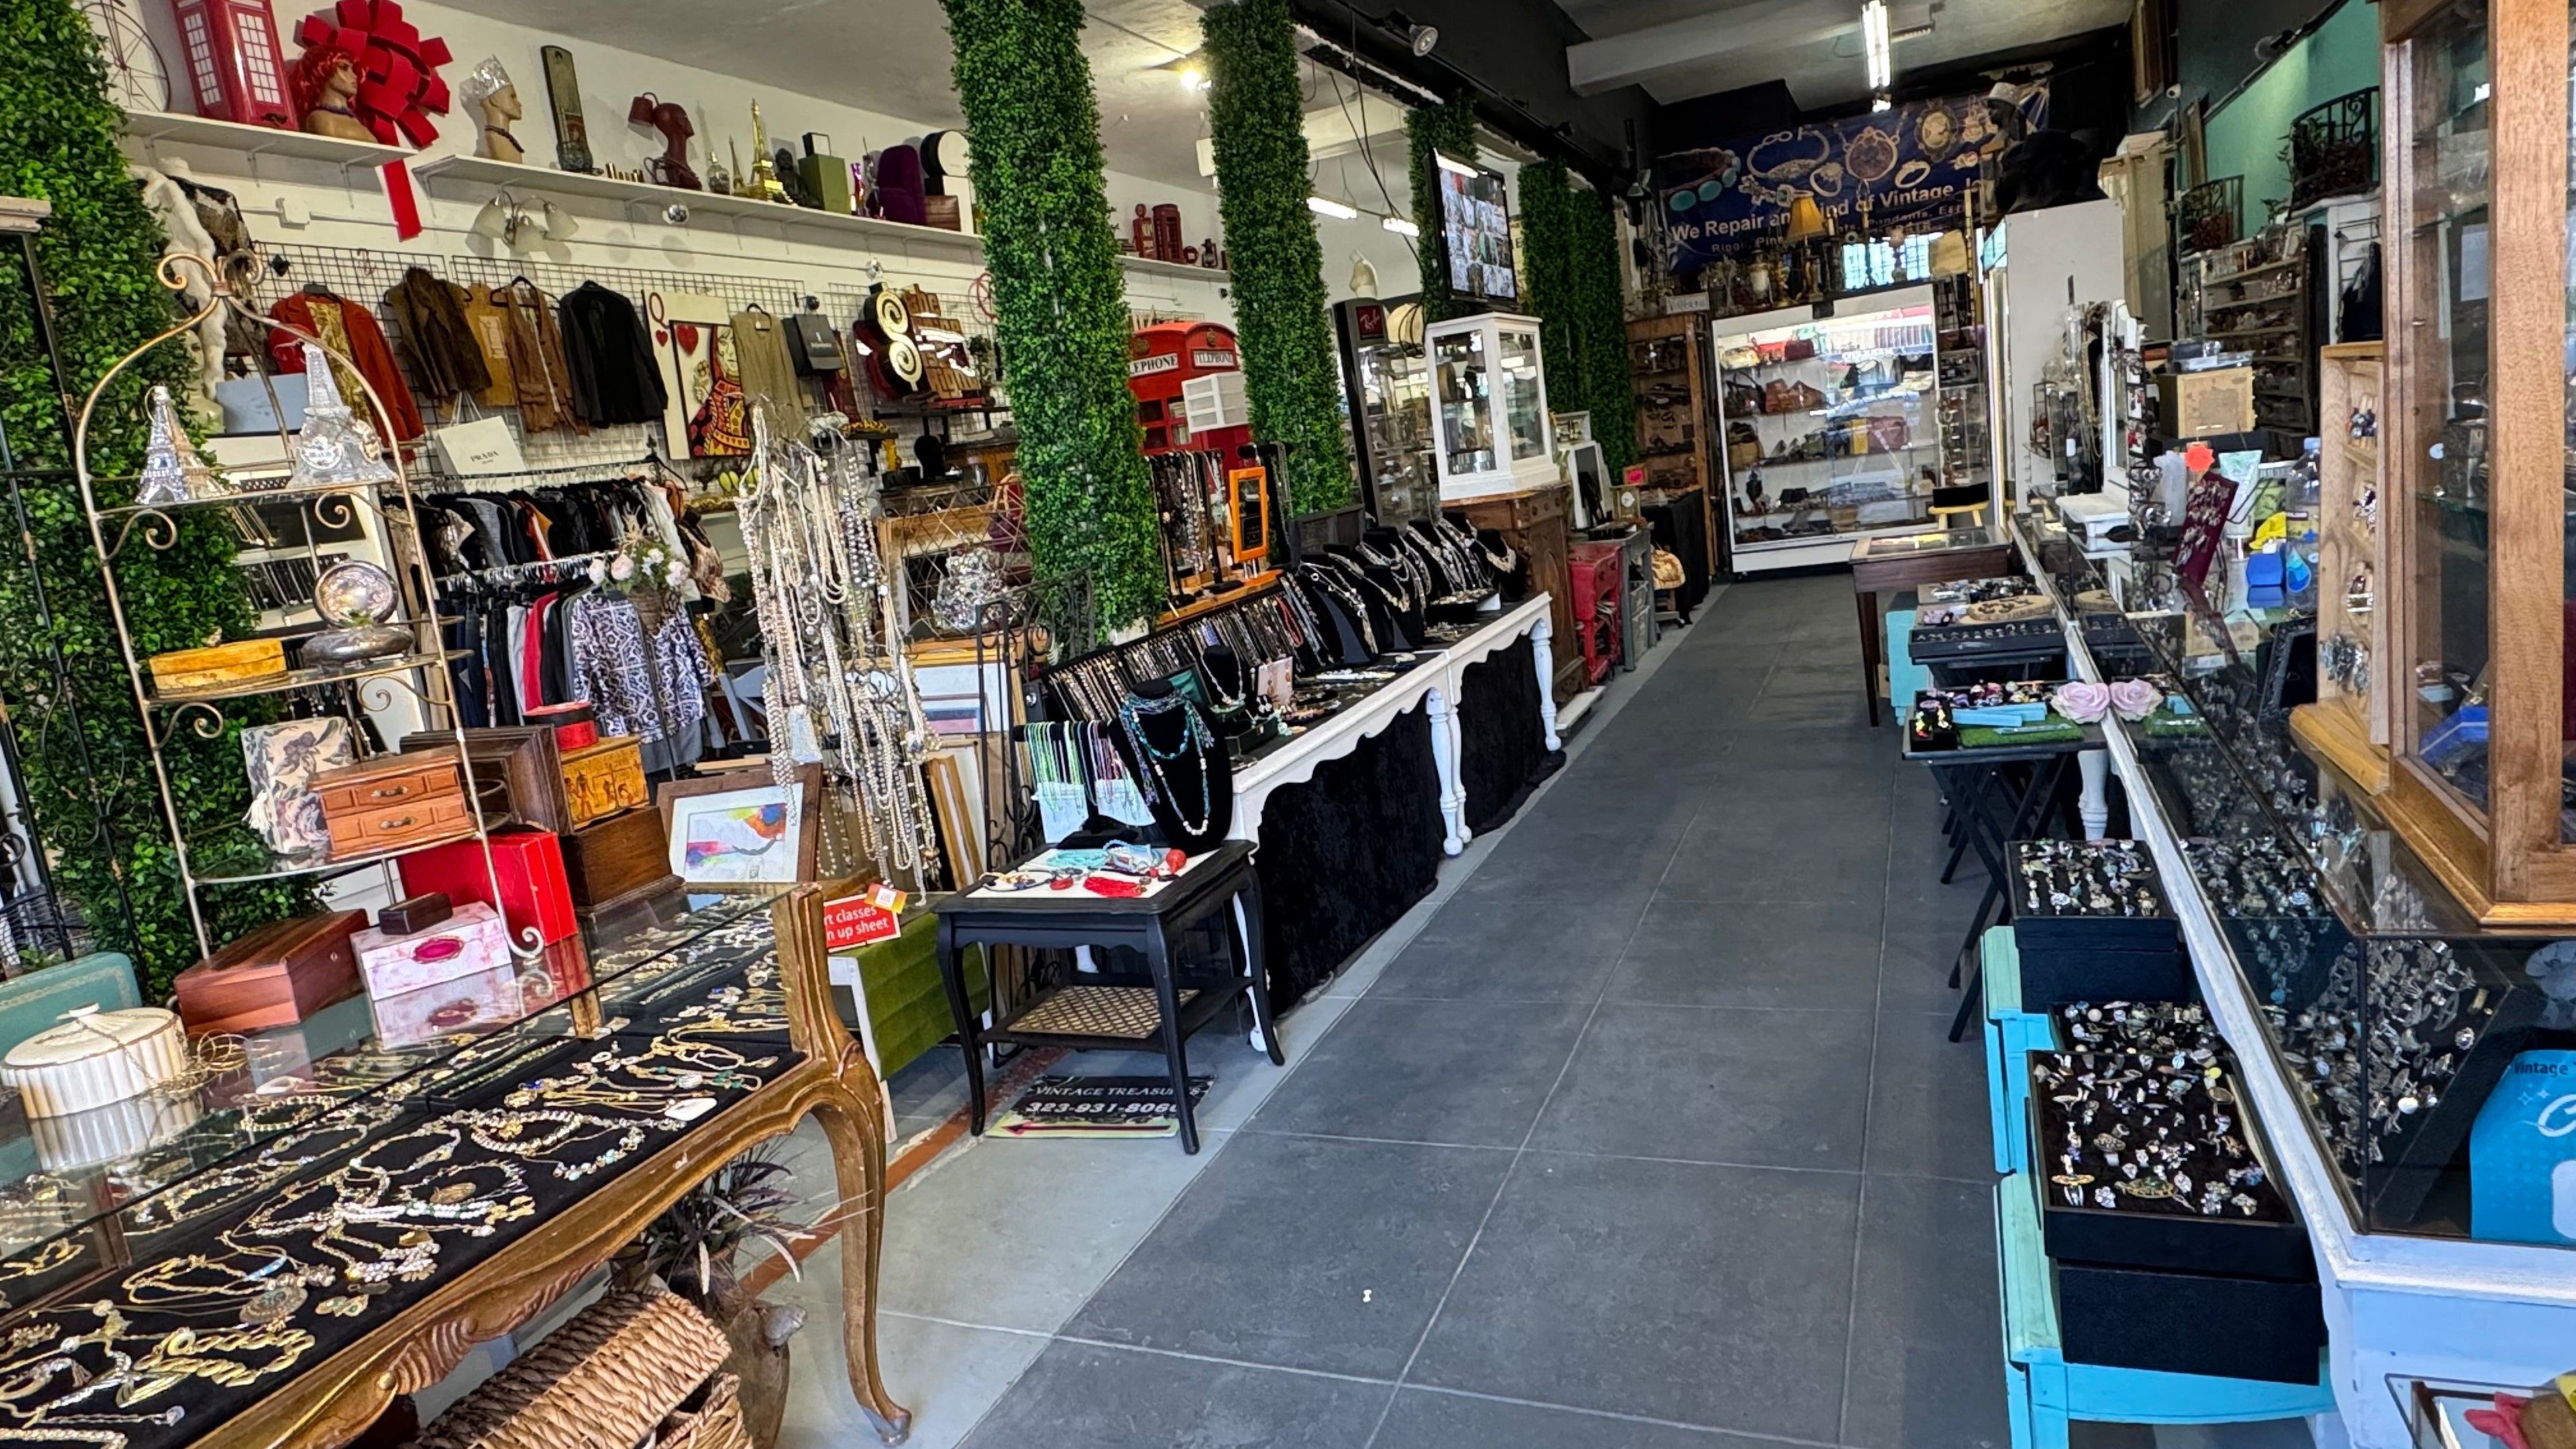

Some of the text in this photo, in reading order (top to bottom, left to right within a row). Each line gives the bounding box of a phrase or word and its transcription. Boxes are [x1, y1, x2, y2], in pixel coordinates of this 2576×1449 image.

[1671, 224, 1700, 241] We
[1705, 213, 1765, 237] Repair
[1769, 212, 1791, 227] an
[1819, 199, 1849, 217] ind
[1879, 184, 1954, 209] Vintage
[649, 291, 670, 329] Q
[1129, 354, 1178, 374] LEPHONE
[1195, 351, 1232, 364] TELEPHONE
[470, 449, 500, 462] PRADA
[823, 906, 878, 927] rt classes
[837, 926, 854, 941] up
[855, 917, 890, 935] sheet
[2514, 1062, 2569, 1078] Vintage
[1036, 1086, 1201, 1096] VINTAGE TREASUS
